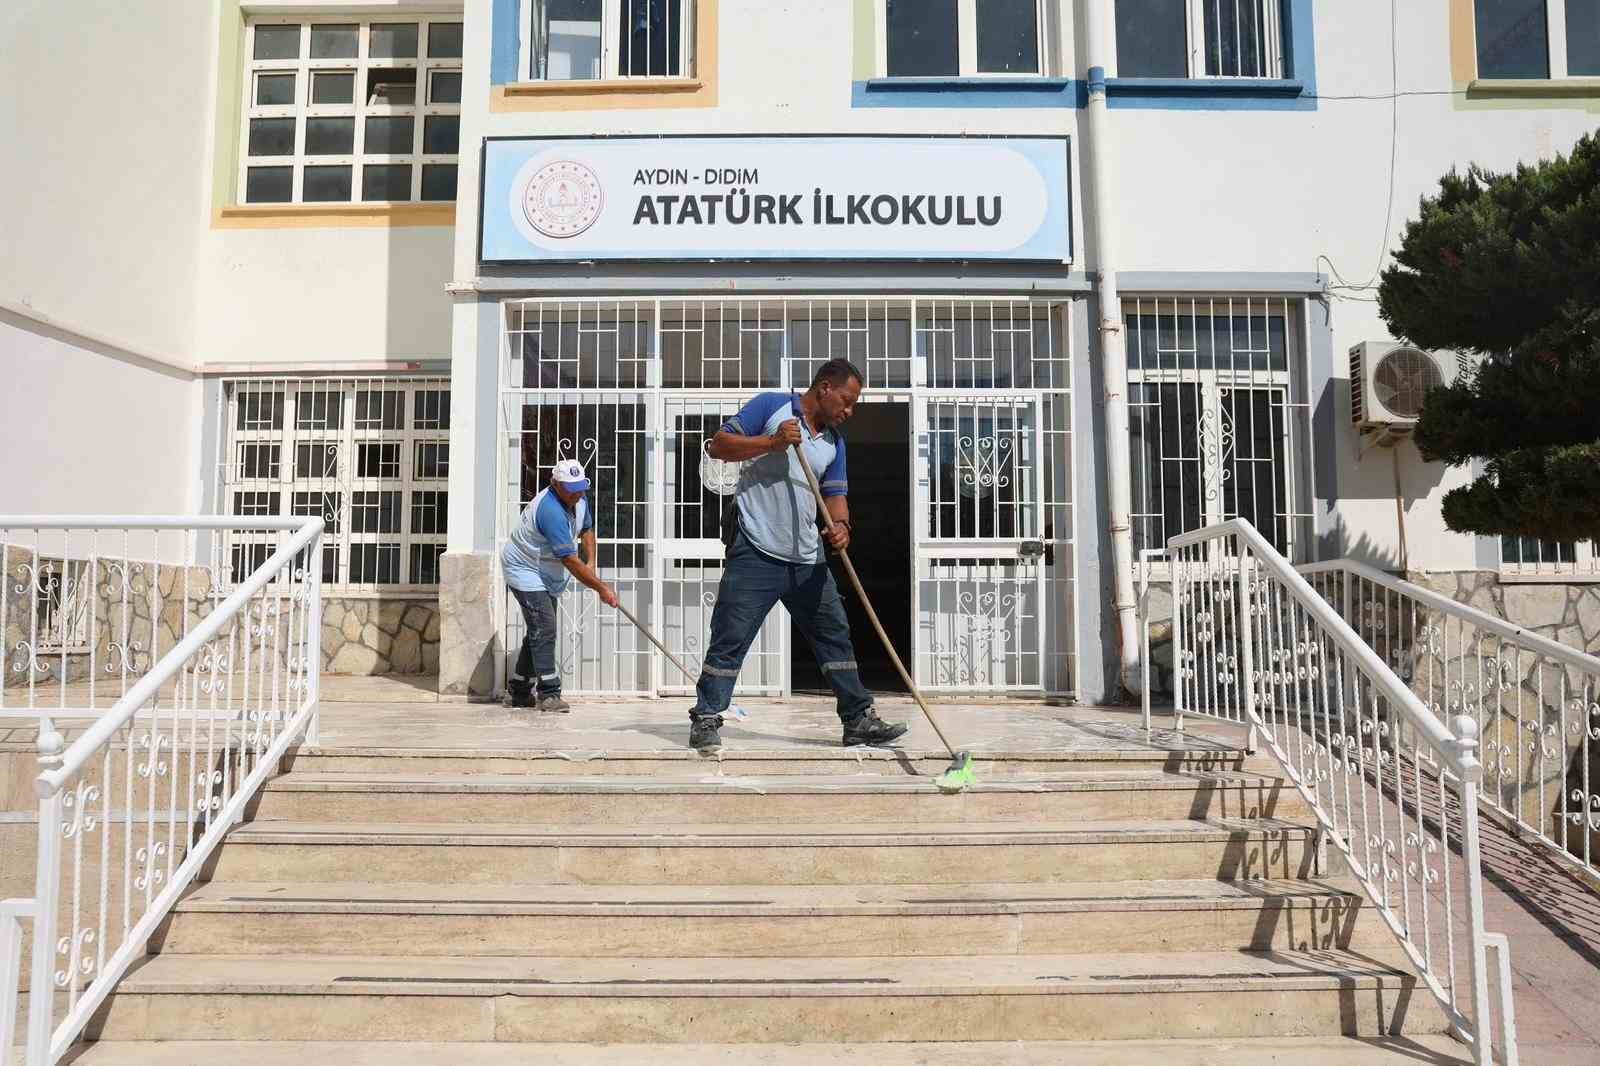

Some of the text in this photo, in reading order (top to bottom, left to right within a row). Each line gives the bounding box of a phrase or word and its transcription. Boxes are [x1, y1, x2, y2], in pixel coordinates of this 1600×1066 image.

[633, 168, 688, 185] AYDIN
[632, 187, 804, 226] ATATÜRK
[813, 187, 1002, 227] İLKOKULU
